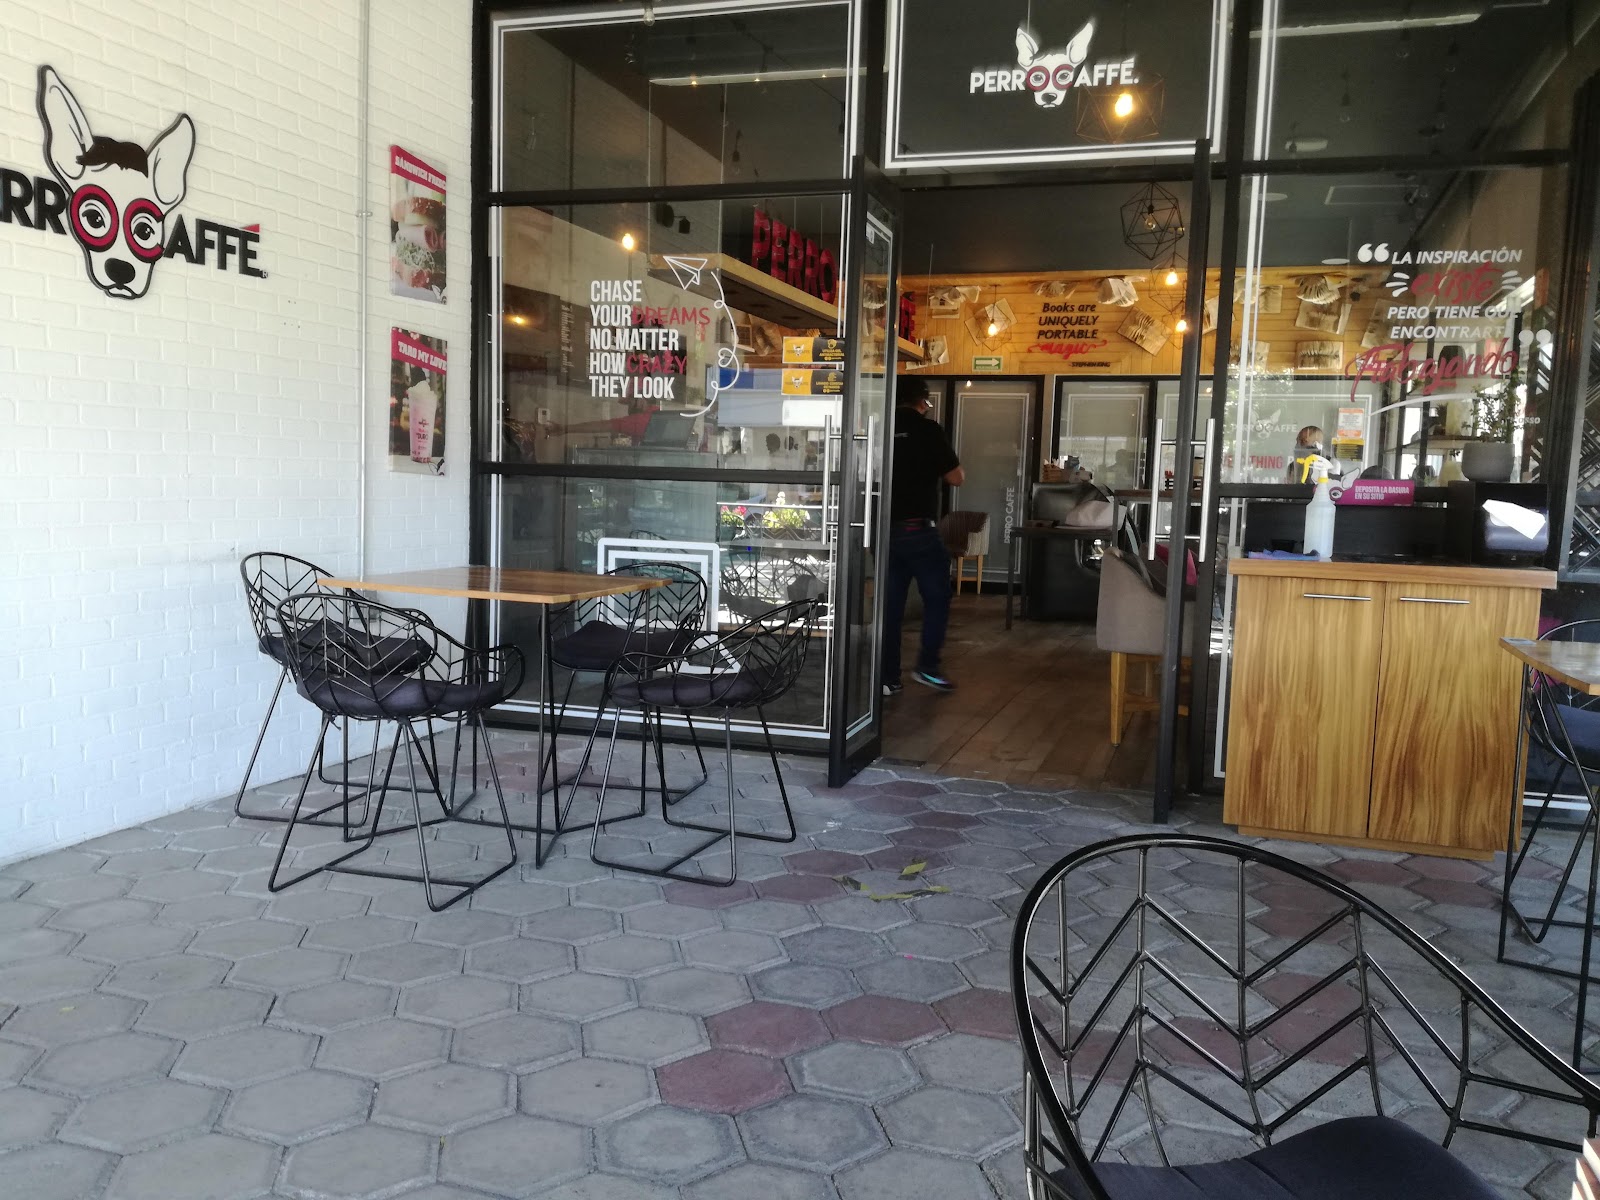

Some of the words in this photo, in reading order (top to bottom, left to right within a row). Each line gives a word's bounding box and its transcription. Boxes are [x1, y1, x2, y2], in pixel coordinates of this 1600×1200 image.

[751, 208, 838, 305] PERRO
[1415, 245, 1523, 265] INSPIRACIÓN
[590, 280, 643, 302] CHASE
[590, 304, 632, 327] YOUR
[631, 304, 711, 327] DREAMS
[1042, 302, 1076, 313] Books
[1078, 304, 1097, 312] are
[1387, 305, 1430, 320] PERO
[1435, 304, 1482, 319] TIENE
[1038, 315, 1100, 328] UNIQUELY
[590, 328, 612, 350] NO
[615, 328, 679, 351] MATTER
[1037, 329, 1099, 339] PORTABLE
[397, 340, 418, 359] TARO
[417, 349, 430, 364] MY
[589, 352, 627, 375] HOW
[625, 353, 688, 375] CRAZY
[588, 375, 630, 398] THEY
[633, 376, 675, 399] LOOK
